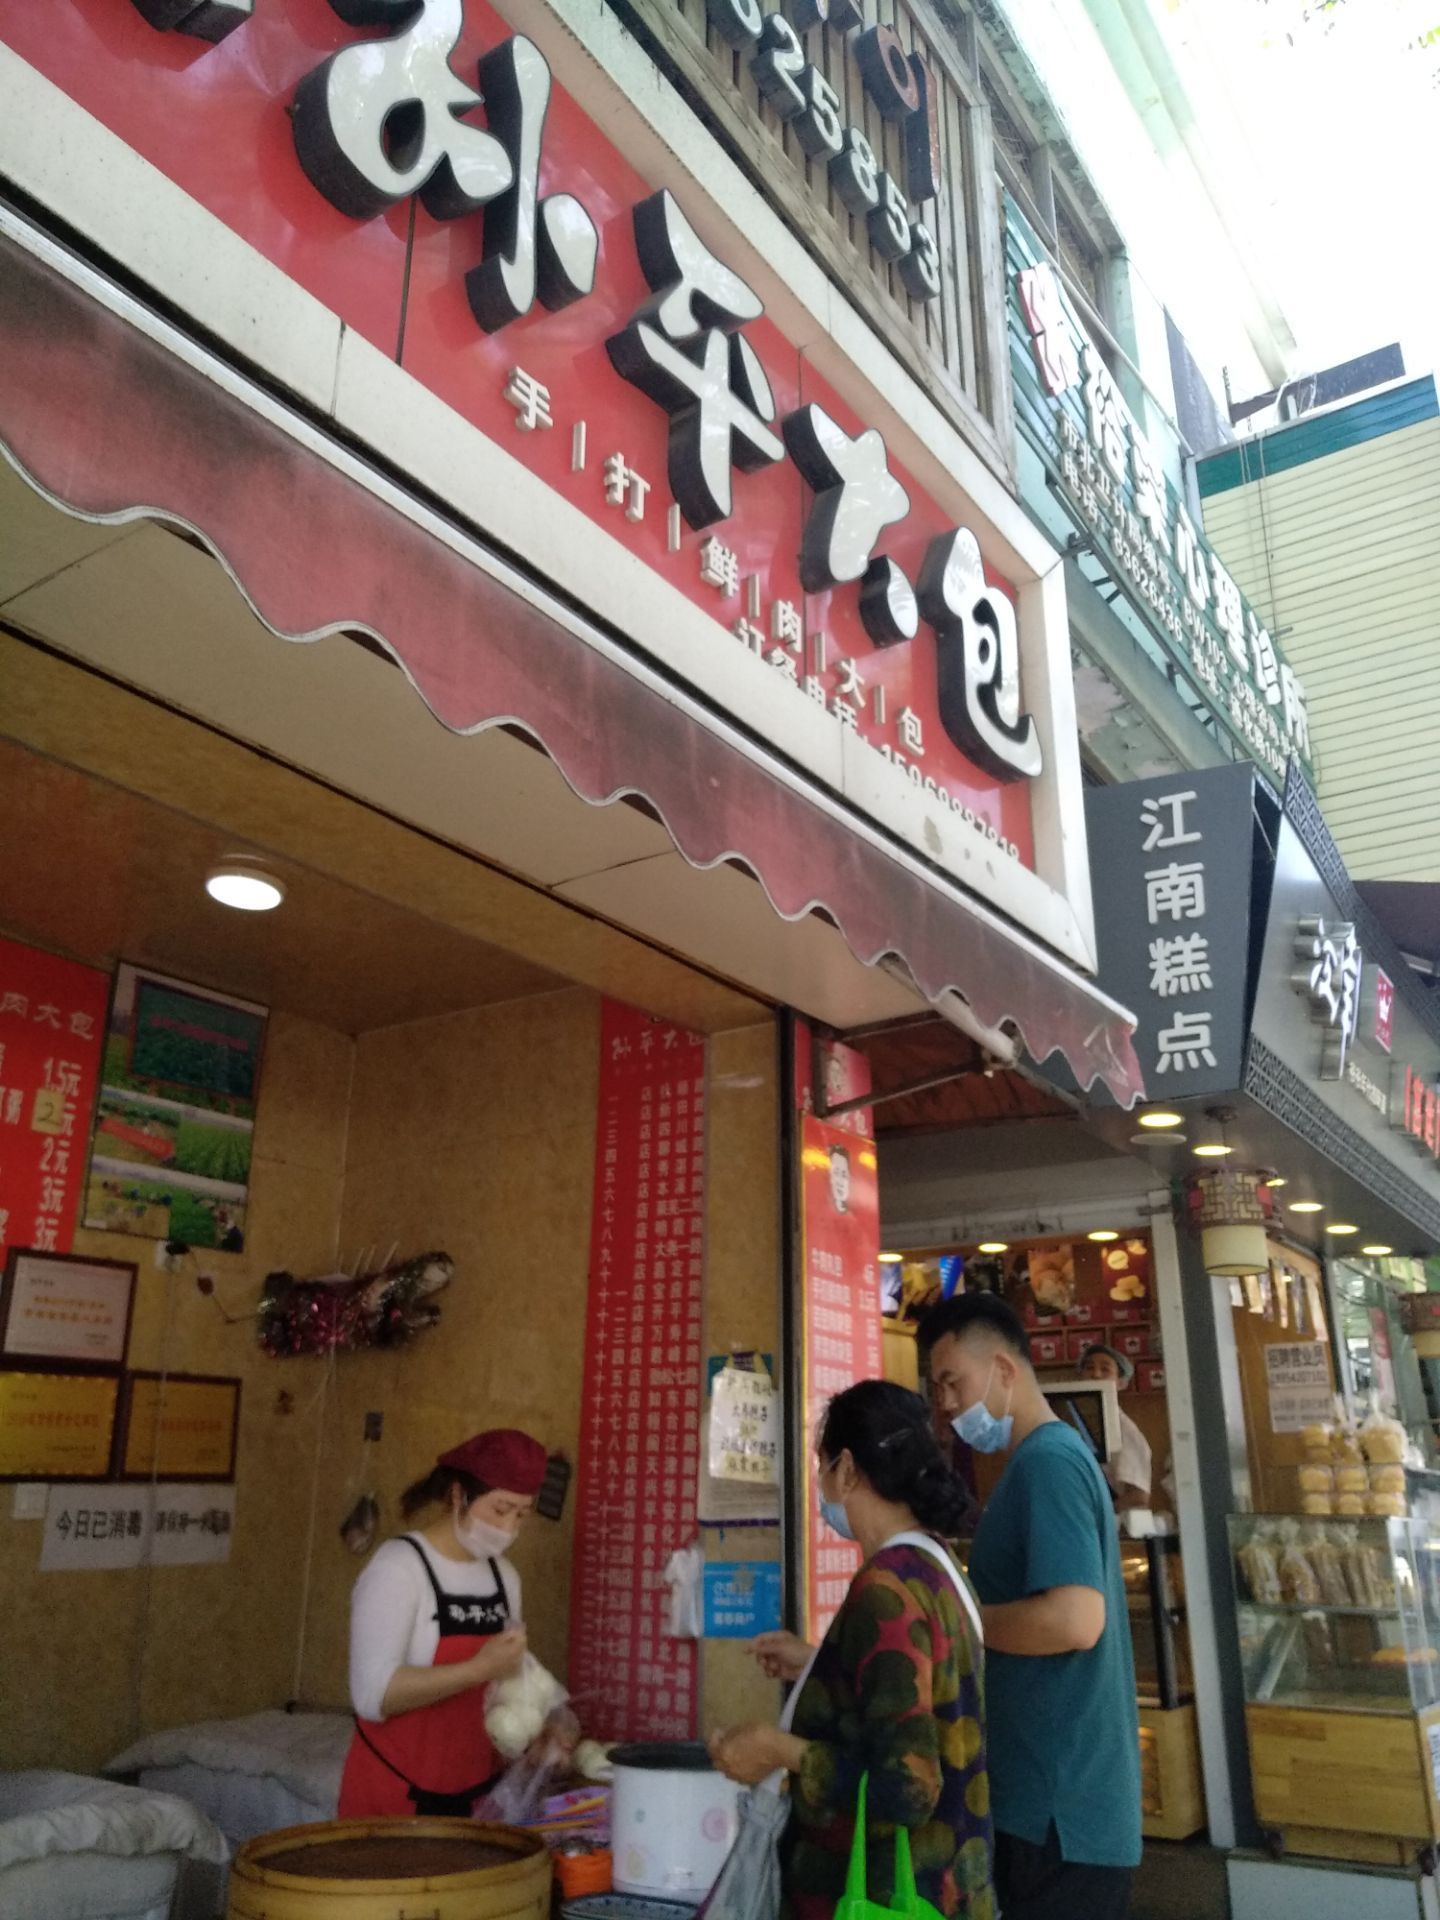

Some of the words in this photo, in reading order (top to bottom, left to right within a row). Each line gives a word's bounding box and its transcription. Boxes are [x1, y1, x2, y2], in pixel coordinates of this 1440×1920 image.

[1140, 790, 1217, 1075] 江南糕点
[40, 1136, 70, 1174] 2元
[56, 1509, 142, 1540] 今日已消毒
